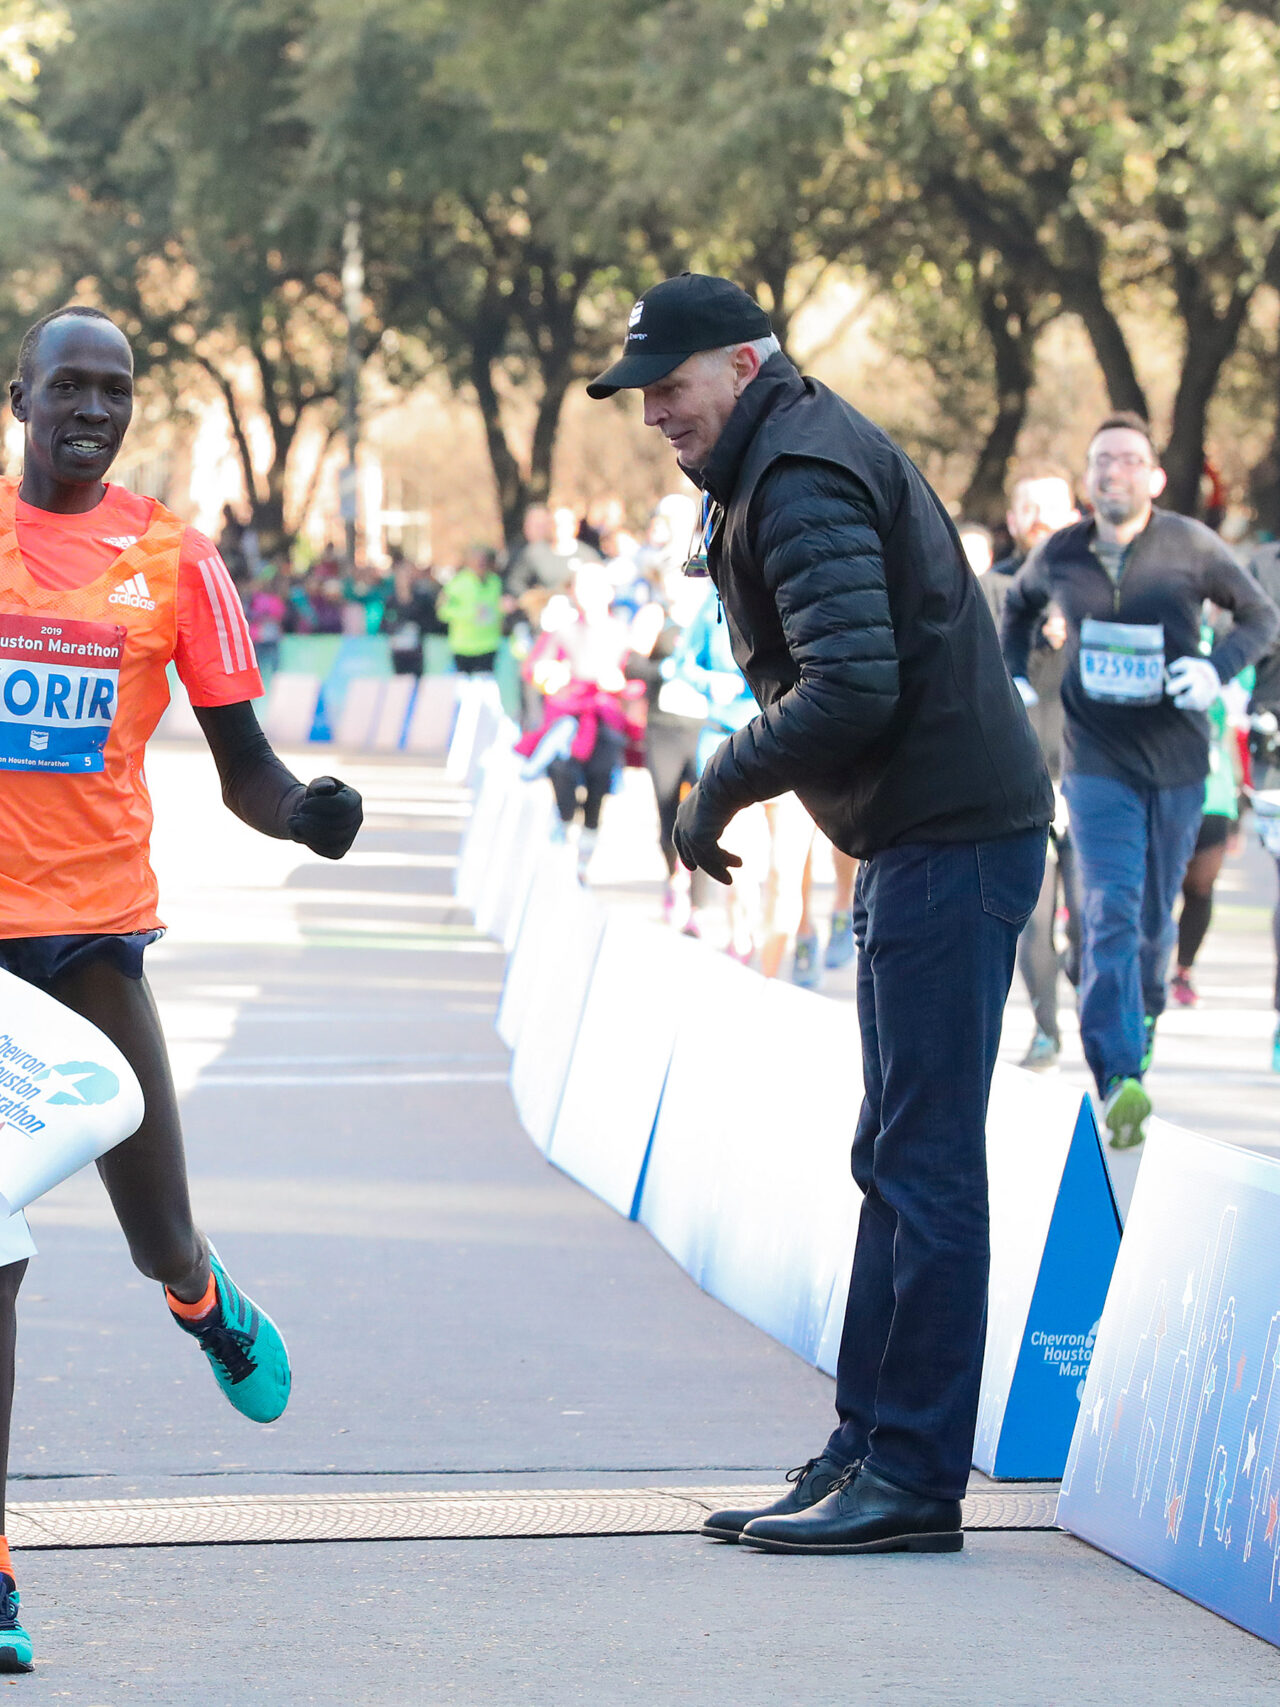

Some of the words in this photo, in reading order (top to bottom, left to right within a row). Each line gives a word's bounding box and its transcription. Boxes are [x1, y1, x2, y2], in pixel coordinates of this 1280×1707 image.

[108, 593, 156, 611] adidas
[40, 626, 62, 636] 2019
[48, 638, 119, 658] Marathon
[8, 756, 37, 766] Houston
[38, 759, 70, 767] Marathon
[84, 756, 92, 767] 5
[1031, 1330, 1086, 1346] Chevron
[1043, 1346, 1093, 1361] Housto
